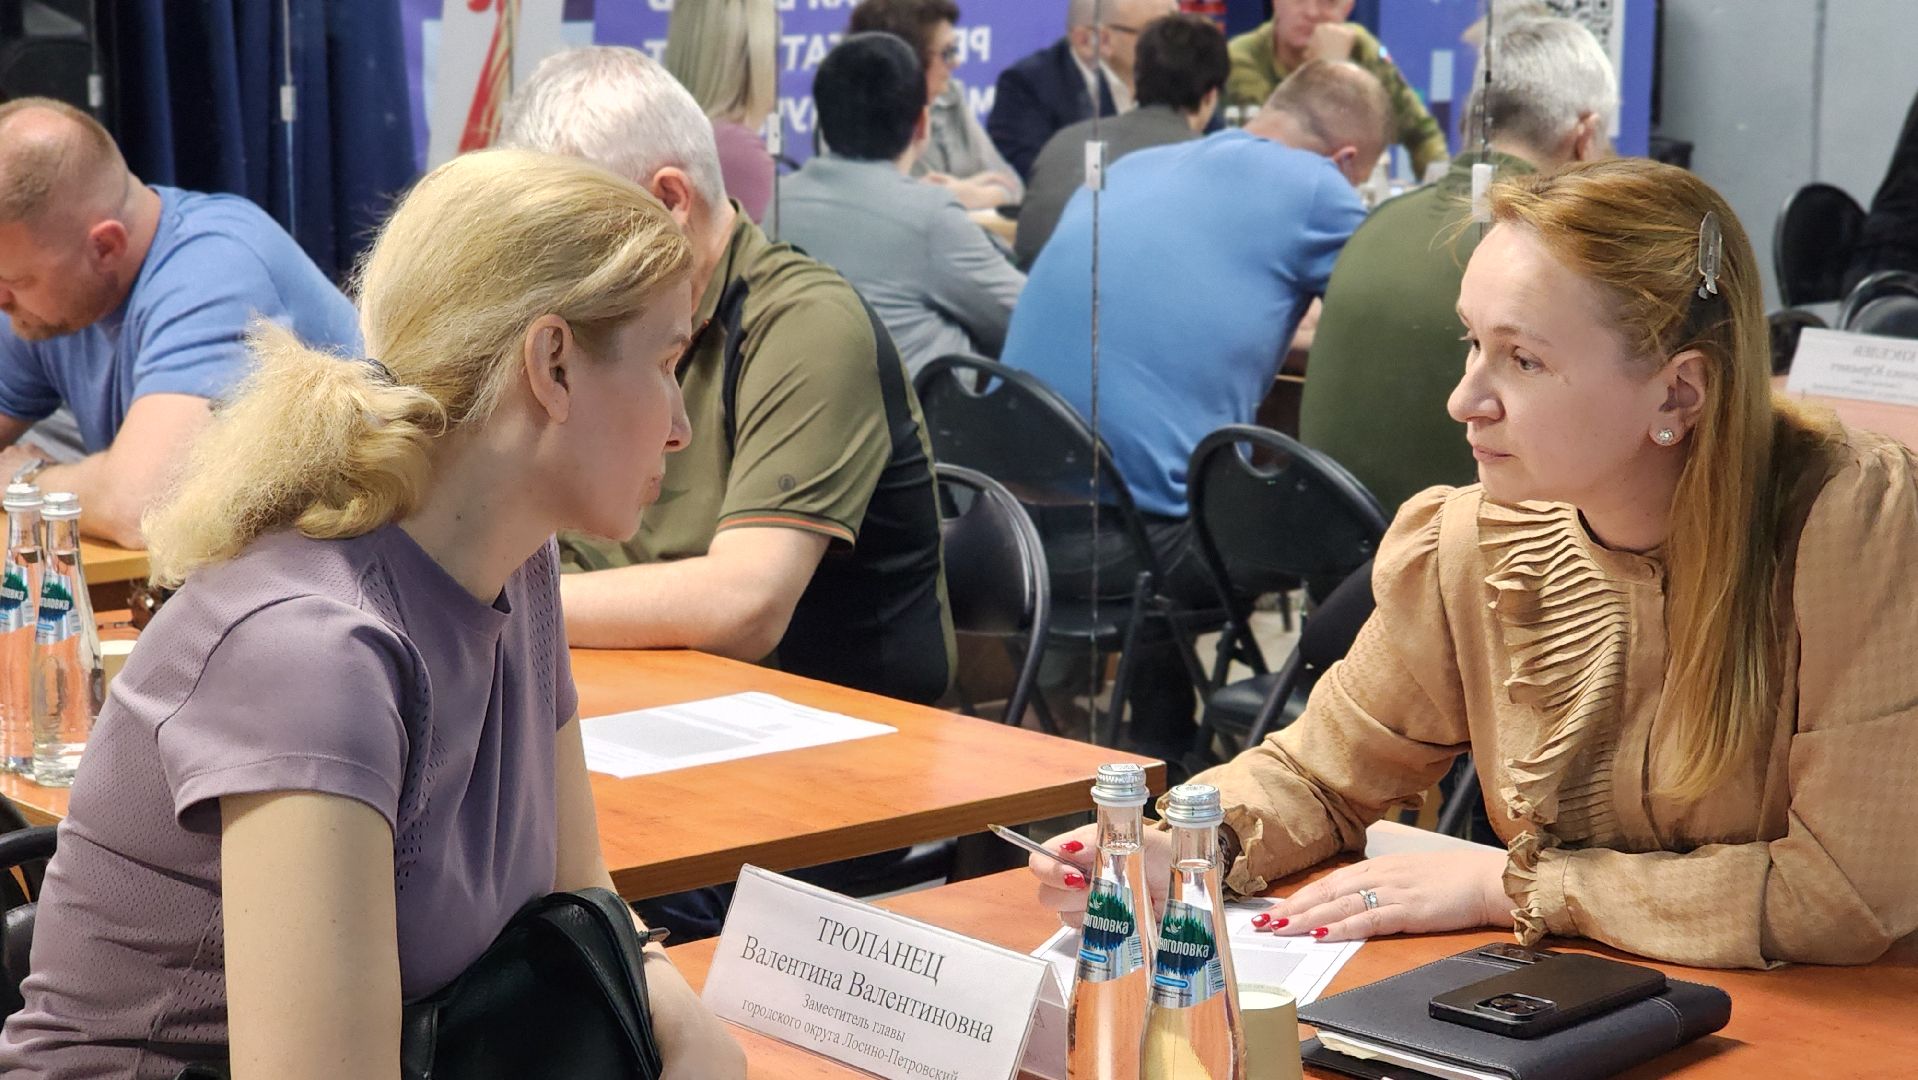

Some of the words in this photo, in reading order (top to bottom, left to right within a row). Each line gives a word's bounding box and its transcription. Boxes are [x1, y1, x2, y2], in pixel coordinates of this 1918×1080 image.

[740, 934, 843, 991] Валентина
[846, 970, 994, 1043] Валентиновна
[817, 916, 945, 986] ТРОПАНЕЦ
[742, 999, 802, 1030] городского
[804, 1022, 840, 1042] округа
[842, 1032, 959, 1080] Лосино-Петровский
[802, 993, 870, 1030] Заместитель
[872, 1021, 906, 1042] главы
